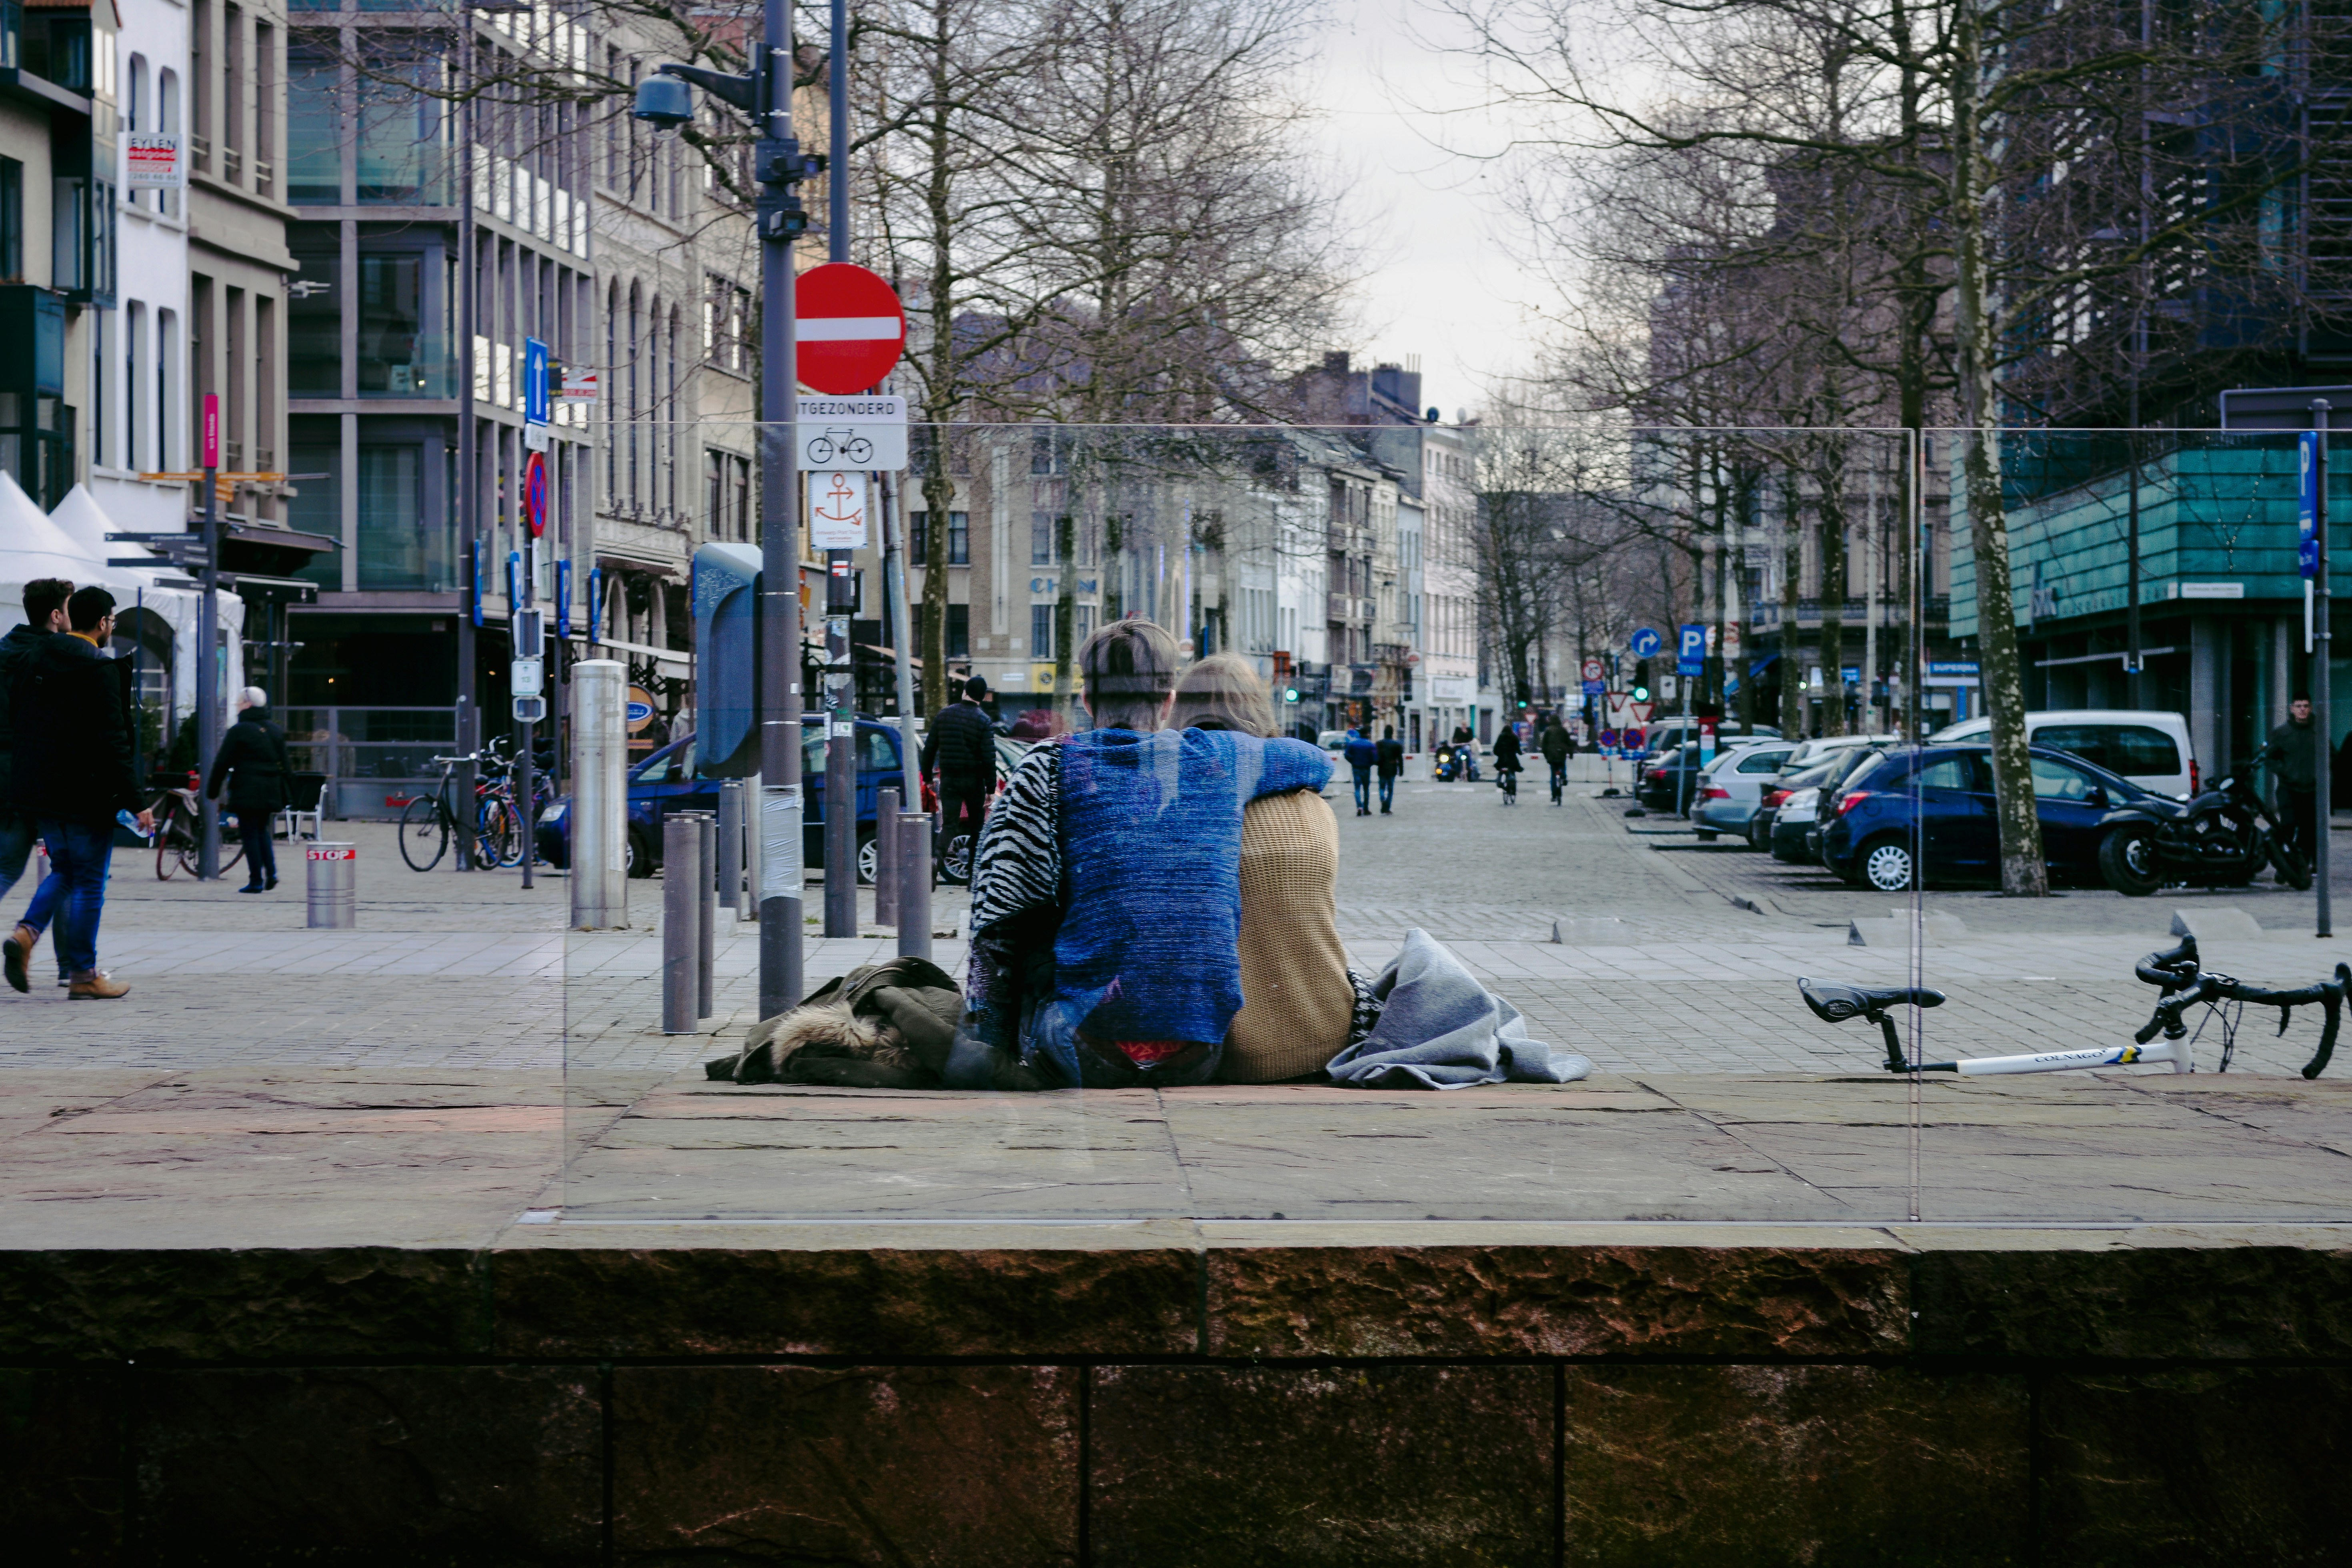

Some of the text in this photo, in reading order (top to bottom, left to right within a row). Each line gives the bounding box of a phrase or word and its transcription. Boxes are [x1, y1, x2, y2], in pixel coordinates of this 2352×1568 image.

[132, 138, 176, 149] EYLEN
[129, 150, 176, 160] astgoed
[795, 403, 895, 415] ITGEZONDERD
[1682, 631, 1702, 657] P
[308, 850, 349, 860] STOP
[2035, 1051, 2103, 1063] COLNAGO
